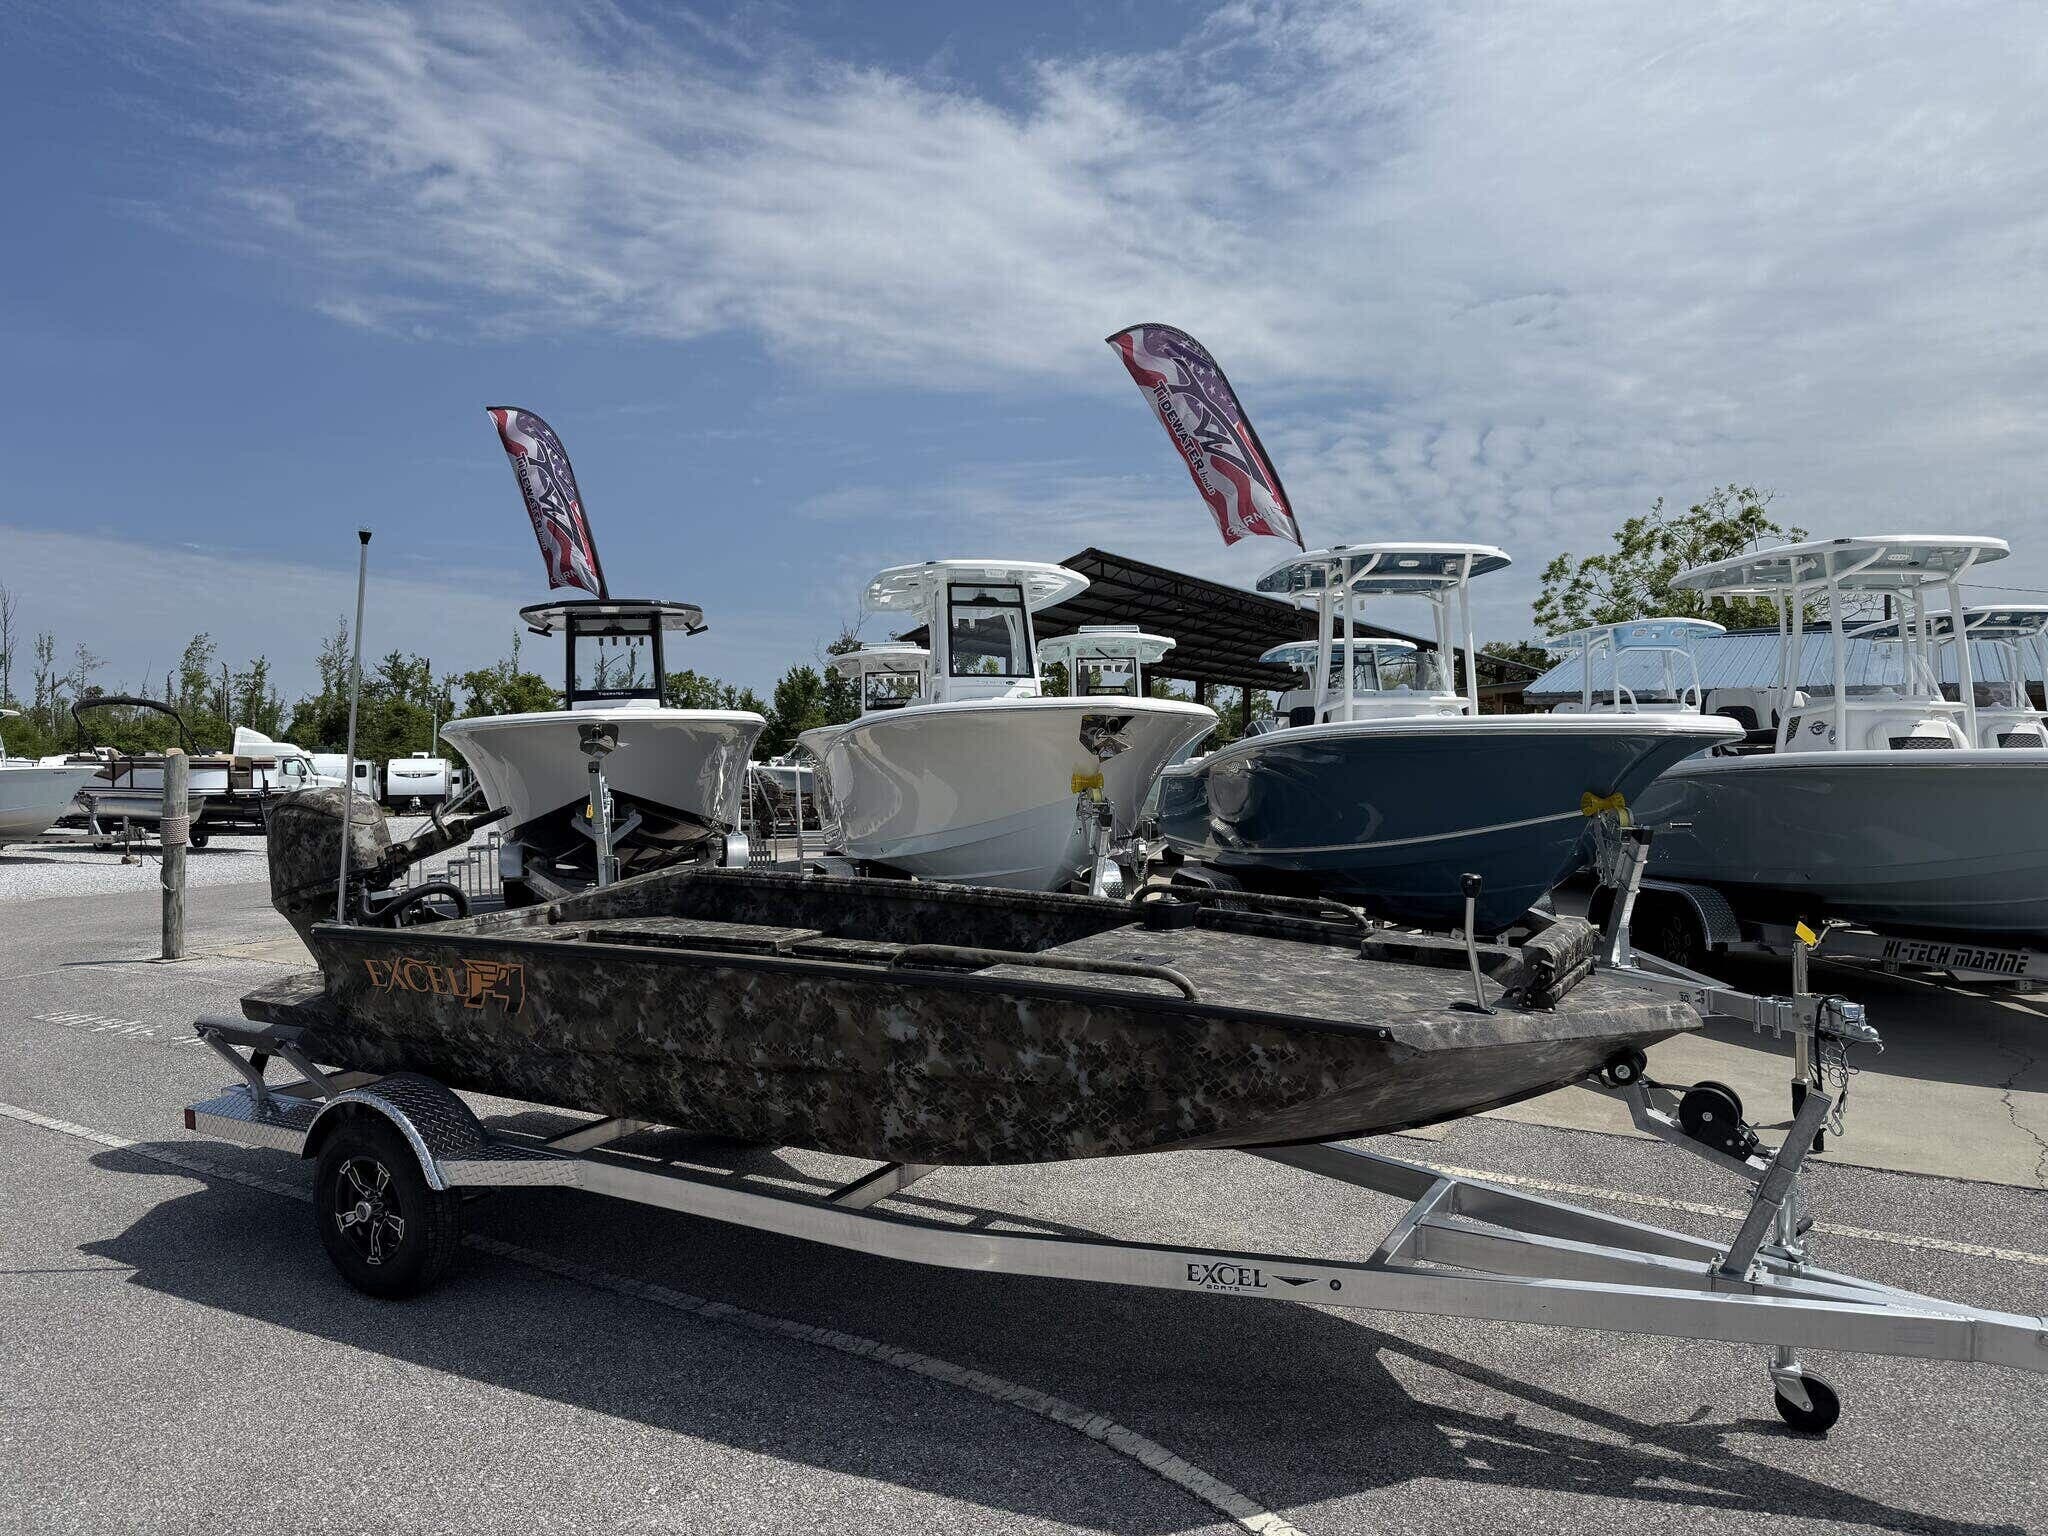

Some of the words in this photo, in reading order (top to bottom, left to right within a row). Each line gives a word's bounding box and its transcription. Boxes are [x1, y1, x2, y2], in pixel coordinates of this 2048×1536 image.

[1153, 380, 1206, 472] TIDEWATER
[515, 451, 543, 534] TIDEWATER
[363, 956, 470, 997] EXCEL
[1882, 939, 1951, 965] HI-TECH
[1952, 948, 2030, 974] MARINE
[1186, 1261, 1268, 1289] EXCEL
